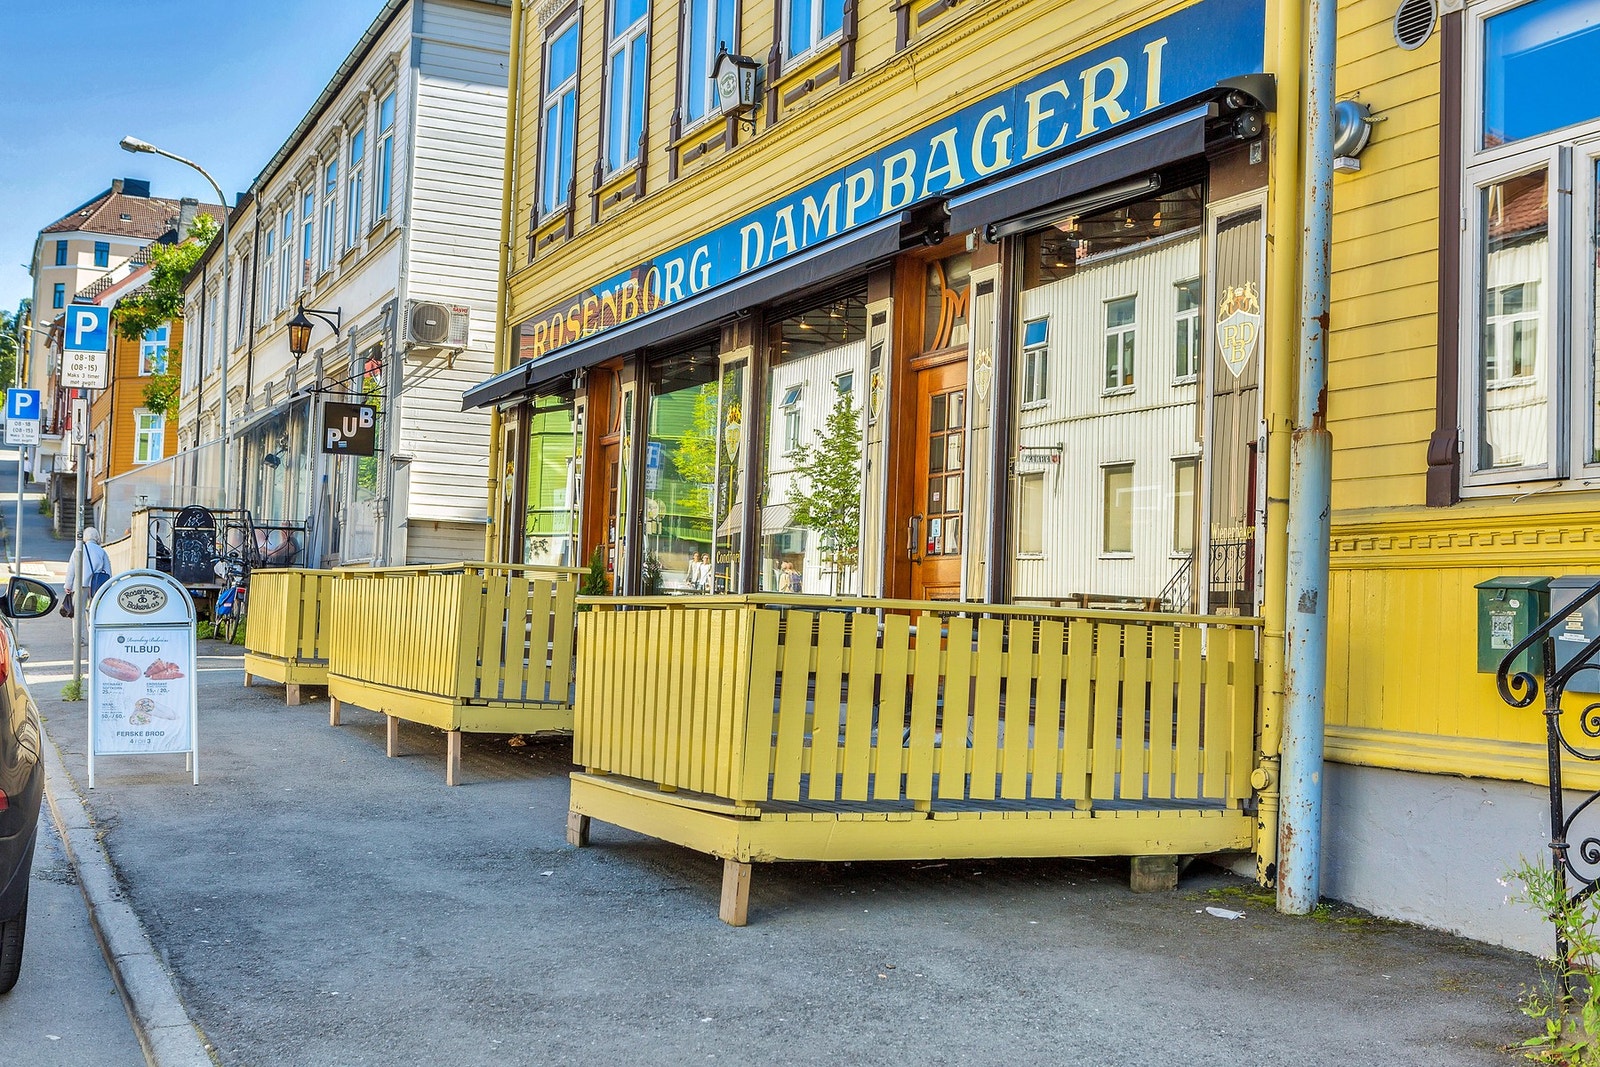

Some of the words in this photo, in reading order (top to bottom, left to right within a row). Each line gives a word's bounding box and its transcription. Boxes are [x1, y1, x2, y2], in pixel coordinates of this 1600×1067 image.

[744, 71, 752, 102] BAKER
[533, 244, 713, 359] ROSENBORG
[738, 35, 1169, 275] DAMPBAGERI
[74, 311, 99, 345] P
[15, 392, 33, 416] P
[326, 407, 374, 449] PUB
[124, 587, 160, 600] Rosenborg
[124, 645, 161, 653] TILBUD
